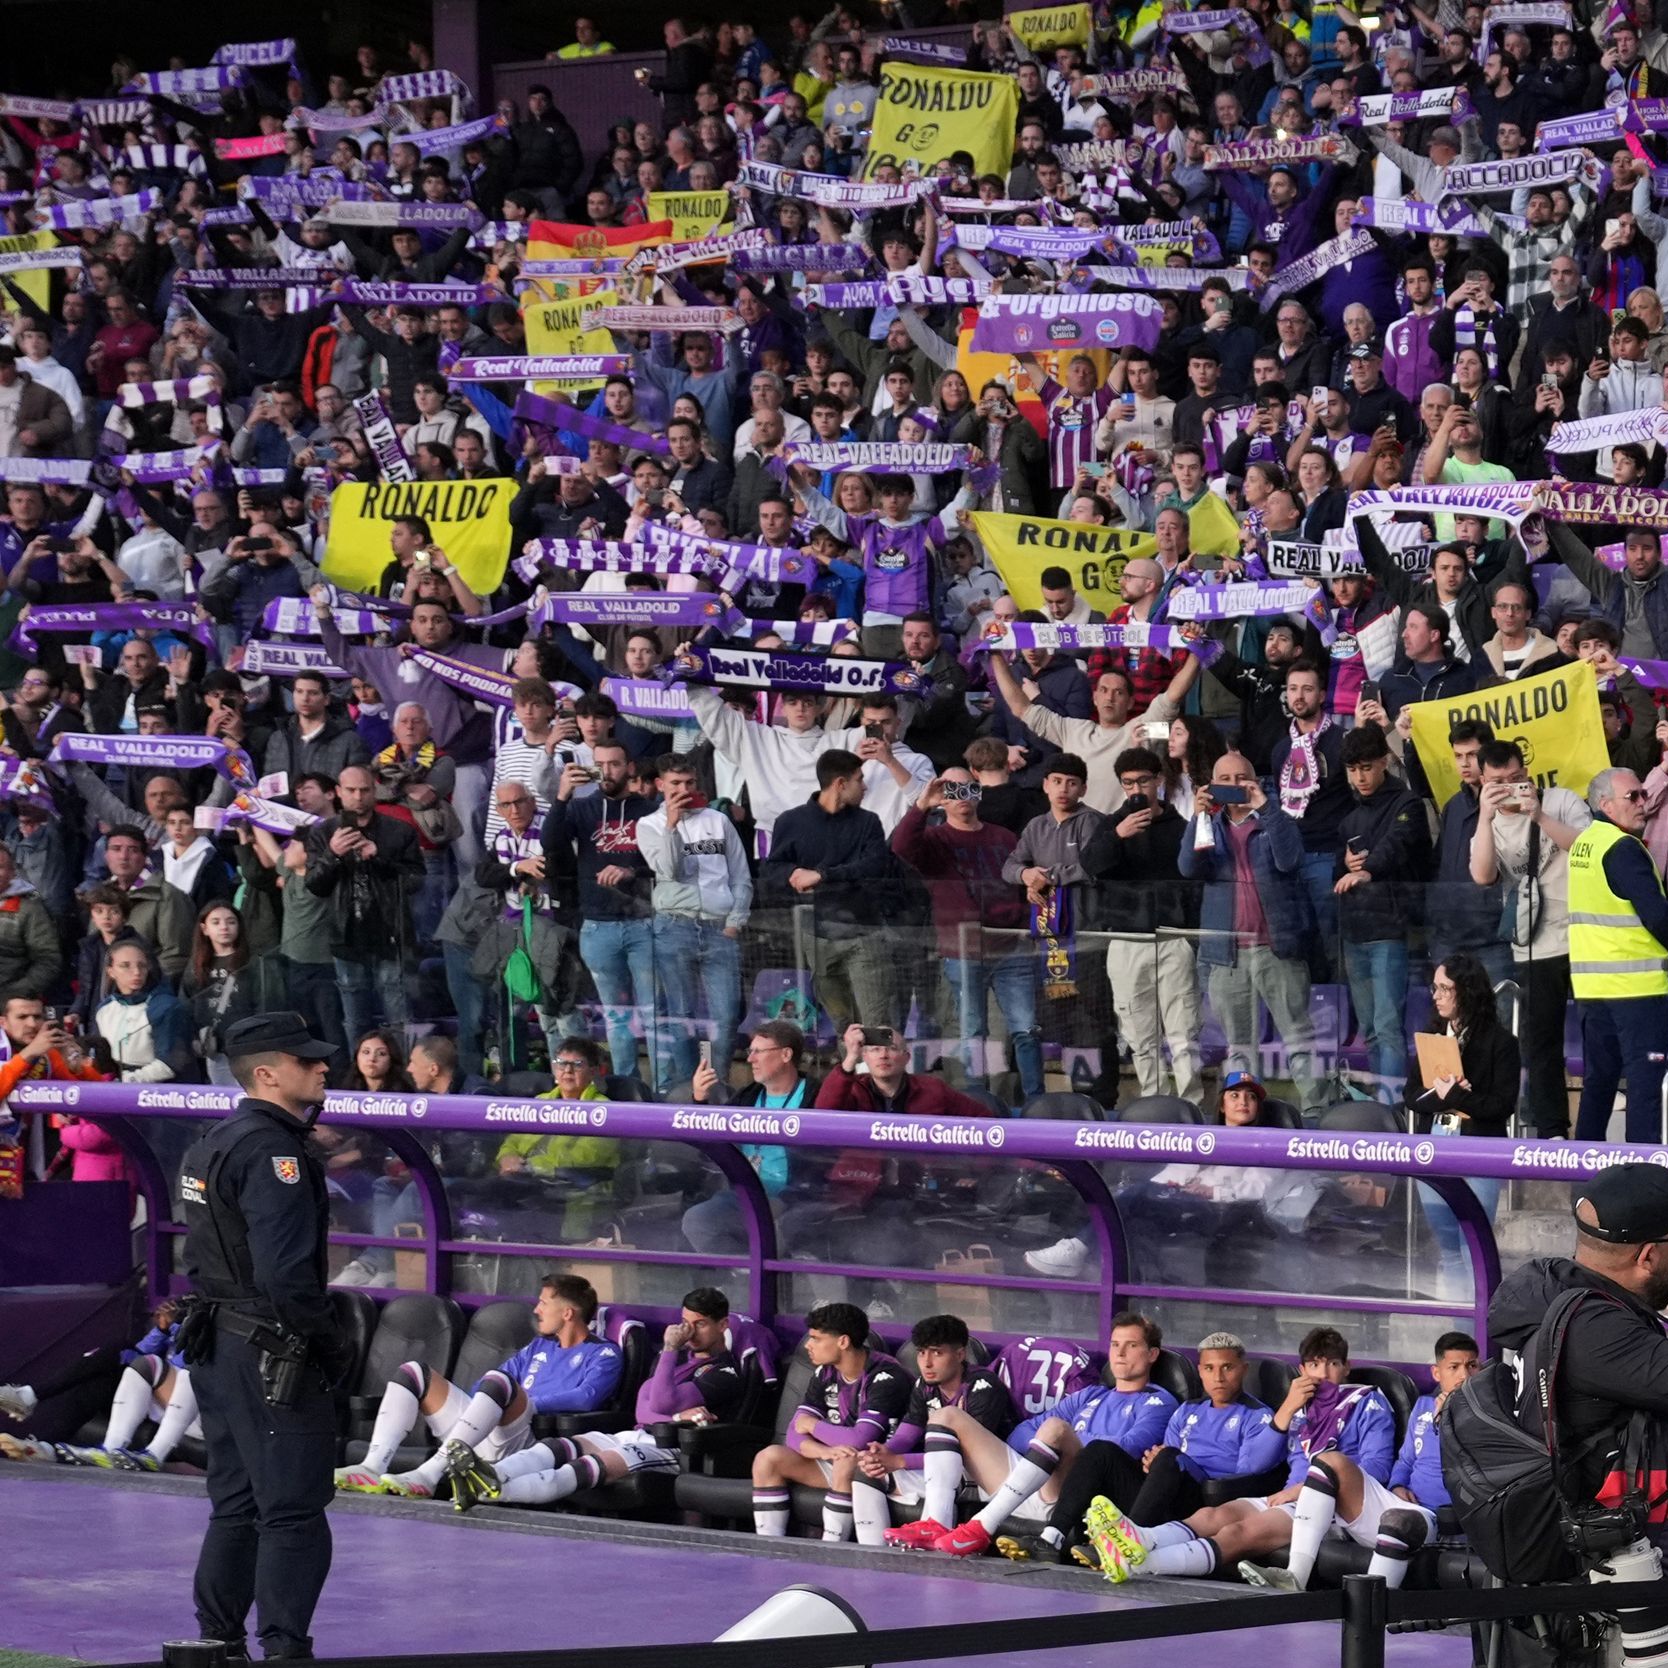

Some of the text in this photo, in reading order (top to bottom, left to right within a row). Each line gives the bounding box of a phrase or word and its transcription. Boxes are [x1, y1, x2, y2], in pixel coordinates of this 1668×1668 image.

[1021, 16, 1077, 35] RONALDO
[1360, 93, 1455, 118] Real Valladolid
[1544, 125, 1572, 141] REAL
[664, 199, 722, 218] RONALDO
[1000, 237, 1028, 252] REAL
[748, 245, 860, 269] PUCELA
[474, 356, 604, 376] Real Valladolid
[848, 442, 955, 467] VALLADOLID
[360, 484, 498, 521] RONALDO
[1272, 547, 1322, 571] REAL
[567, 599, 681, 614] REAL VALLADOLID
[1038, 629, 1097, 646] CLUB DE
[264, 648, 300, 665] REAL
[68, 736, 216, 759] REAL VALLADOLID
[20, 1086, 63, 1105] Galicia
[137, 1090, 231, 1111] Estrella Galicia
[361, 1097, 407, 1117] Galicia
[485, 1102, 587, 1127] Estrella Galicia
[672, 1110, 780, 1136] Estrella Galicia
[870, 1121, 983, 1147] Estrella Galicia
[1075, 1126, 1192, 1153] Estrella Galicia
[1287, 1136, 1411, 1163] Estrella Galicia
[1512, 1145, 1579, 1170] Estrella
[1023, 1348, 1075, 1415] 33
[1538, 1367, 1550, 1409] Canon
